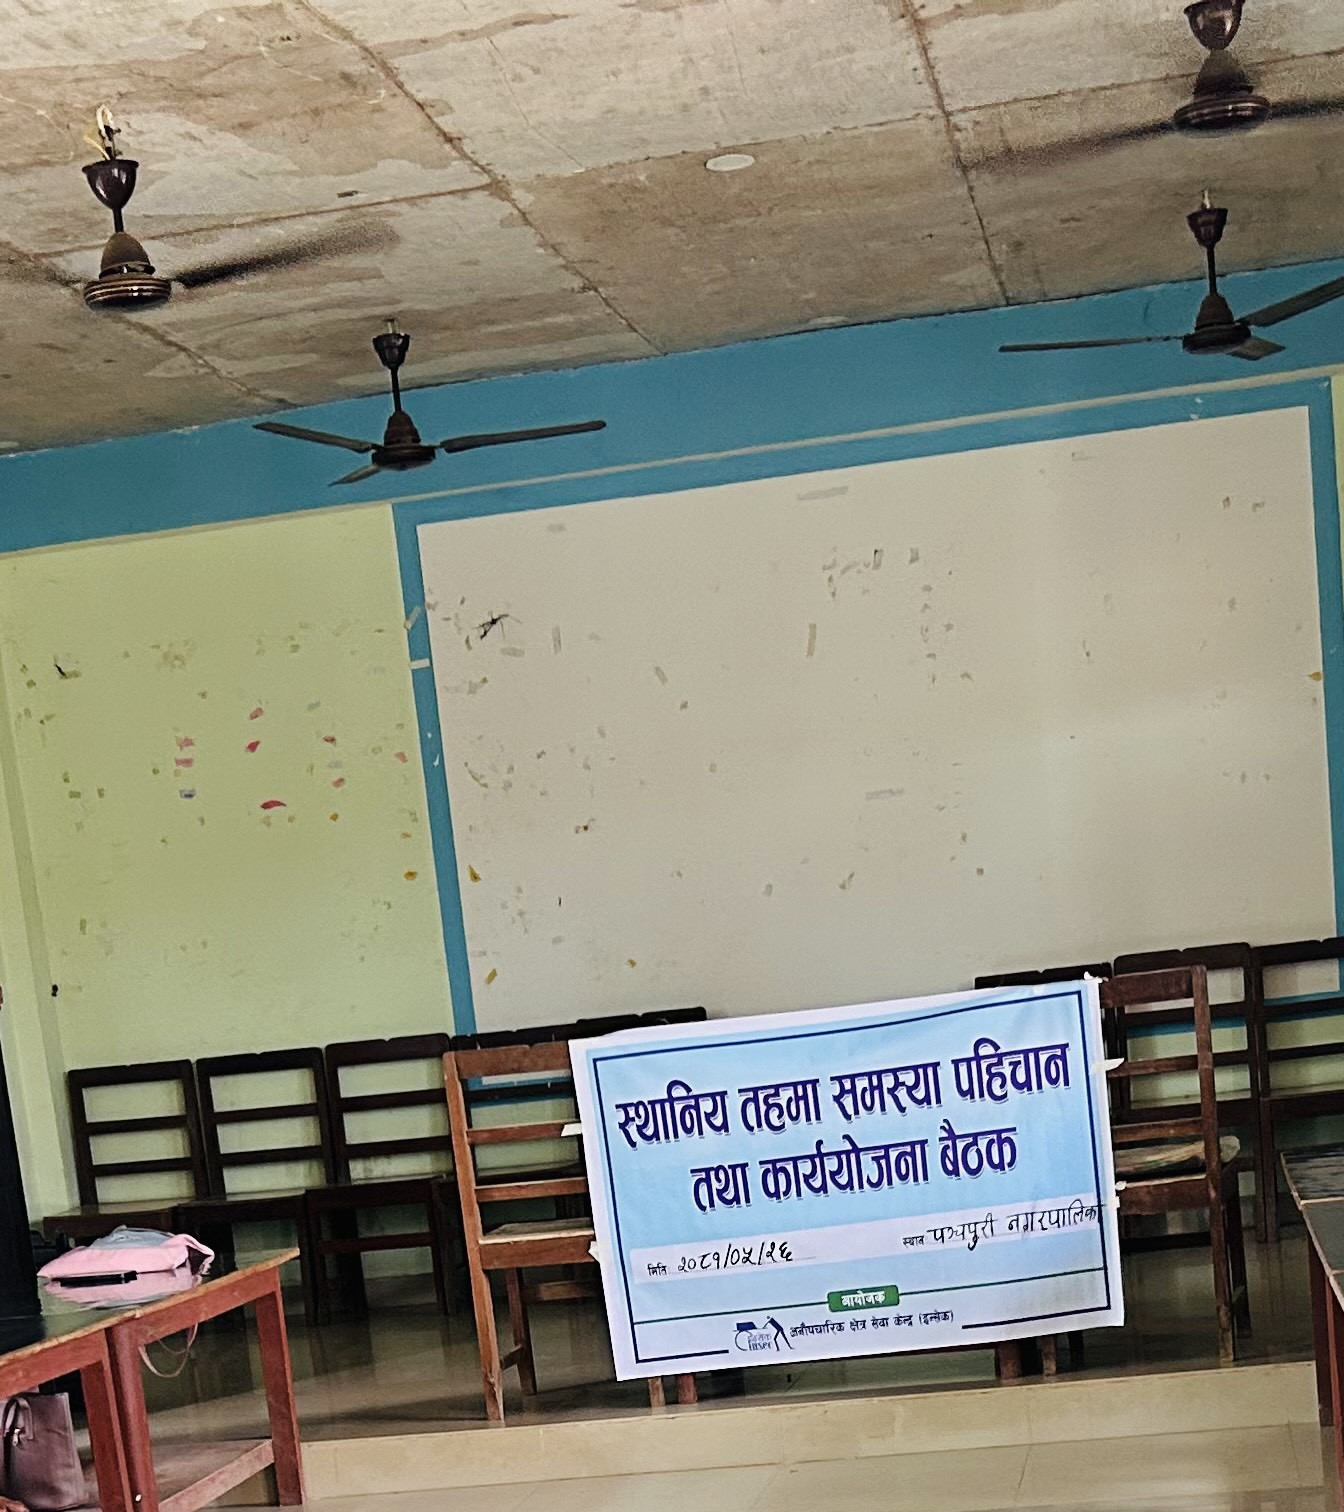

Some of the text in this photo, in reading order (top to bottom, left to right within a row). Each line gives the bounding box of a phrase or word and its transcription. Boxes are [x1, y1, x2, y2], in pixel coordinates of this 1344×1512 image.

[615, 1037, 1070, 1149] स्थानिय तहमा समस्या पहिचान
[690, 1118, 1017, 1214] तथा कार्ययोजना बैठक
[647, 1263, 668, 1277] मिति
[840, 1290, 886, 1308] आयोजक
[849, 1318, 867, 1332] क्षेत्र
[870, 1315, 890, 1330] सेवा
